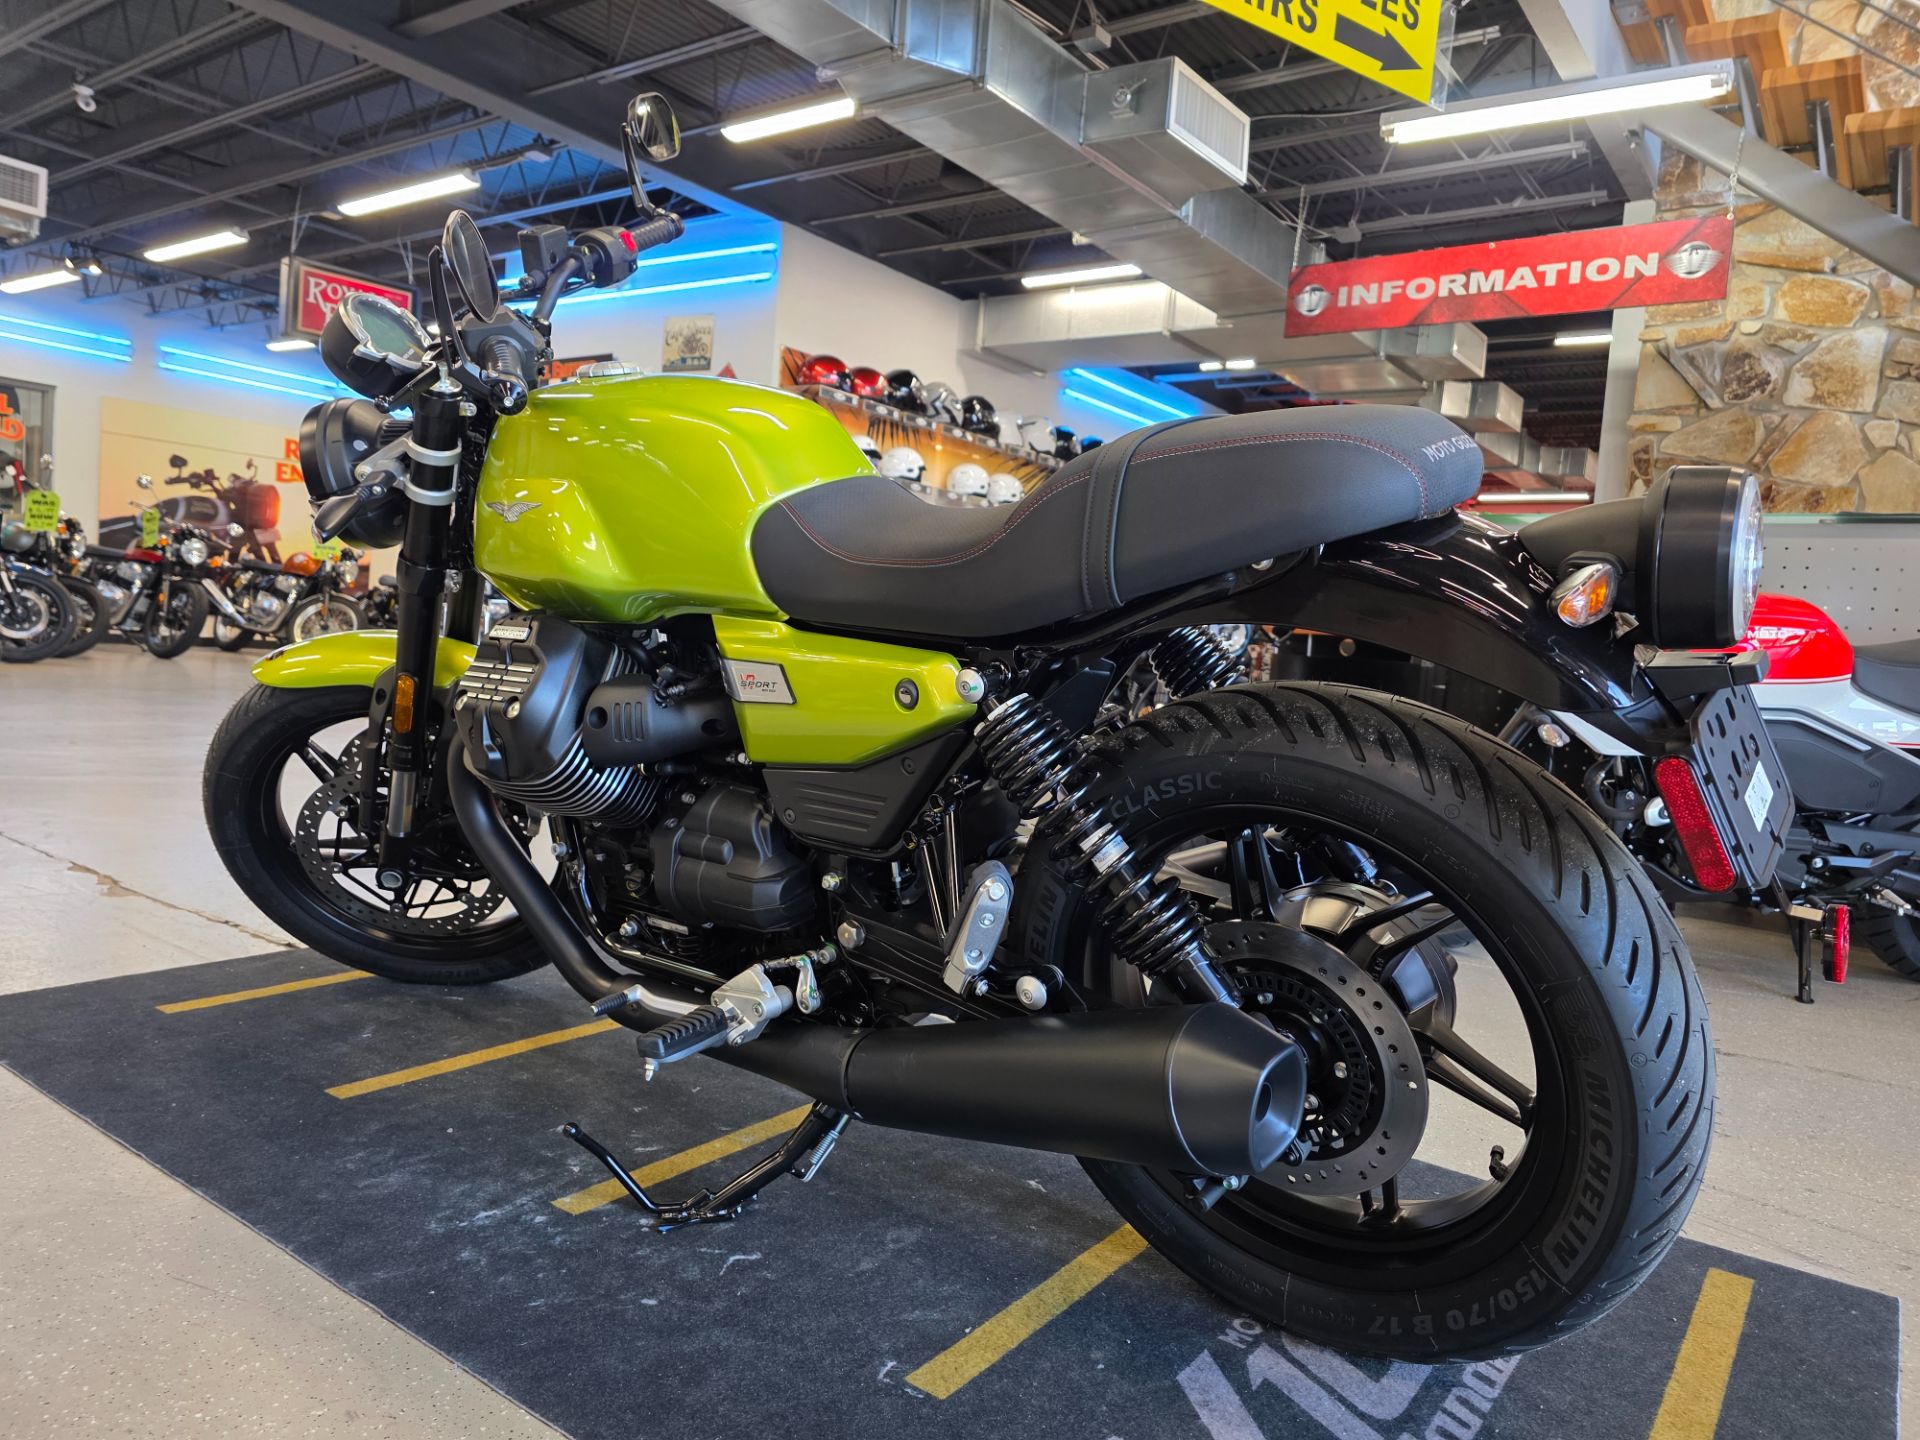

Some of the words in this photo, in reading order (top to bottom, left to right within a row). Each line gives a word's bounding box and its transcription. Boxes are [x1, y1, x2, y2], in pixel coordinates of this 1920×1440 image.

[1337, 252, 1660, 308] INFORMATION
[1421, 440, 1456, 462] MOTO
[740, 680, 778, 689] SPORT
[1110, 771, 1222, 819] CLASSIC
[1028, 884, 1058, 958] ELIN
[1553, 1068, 1613, 1268] MICHELIN
[1446, 1267, 1547, 1330] 150/70
[1367, 1315, 1403, 1335] 17
[1412, 1315, 1434, 1335] B
